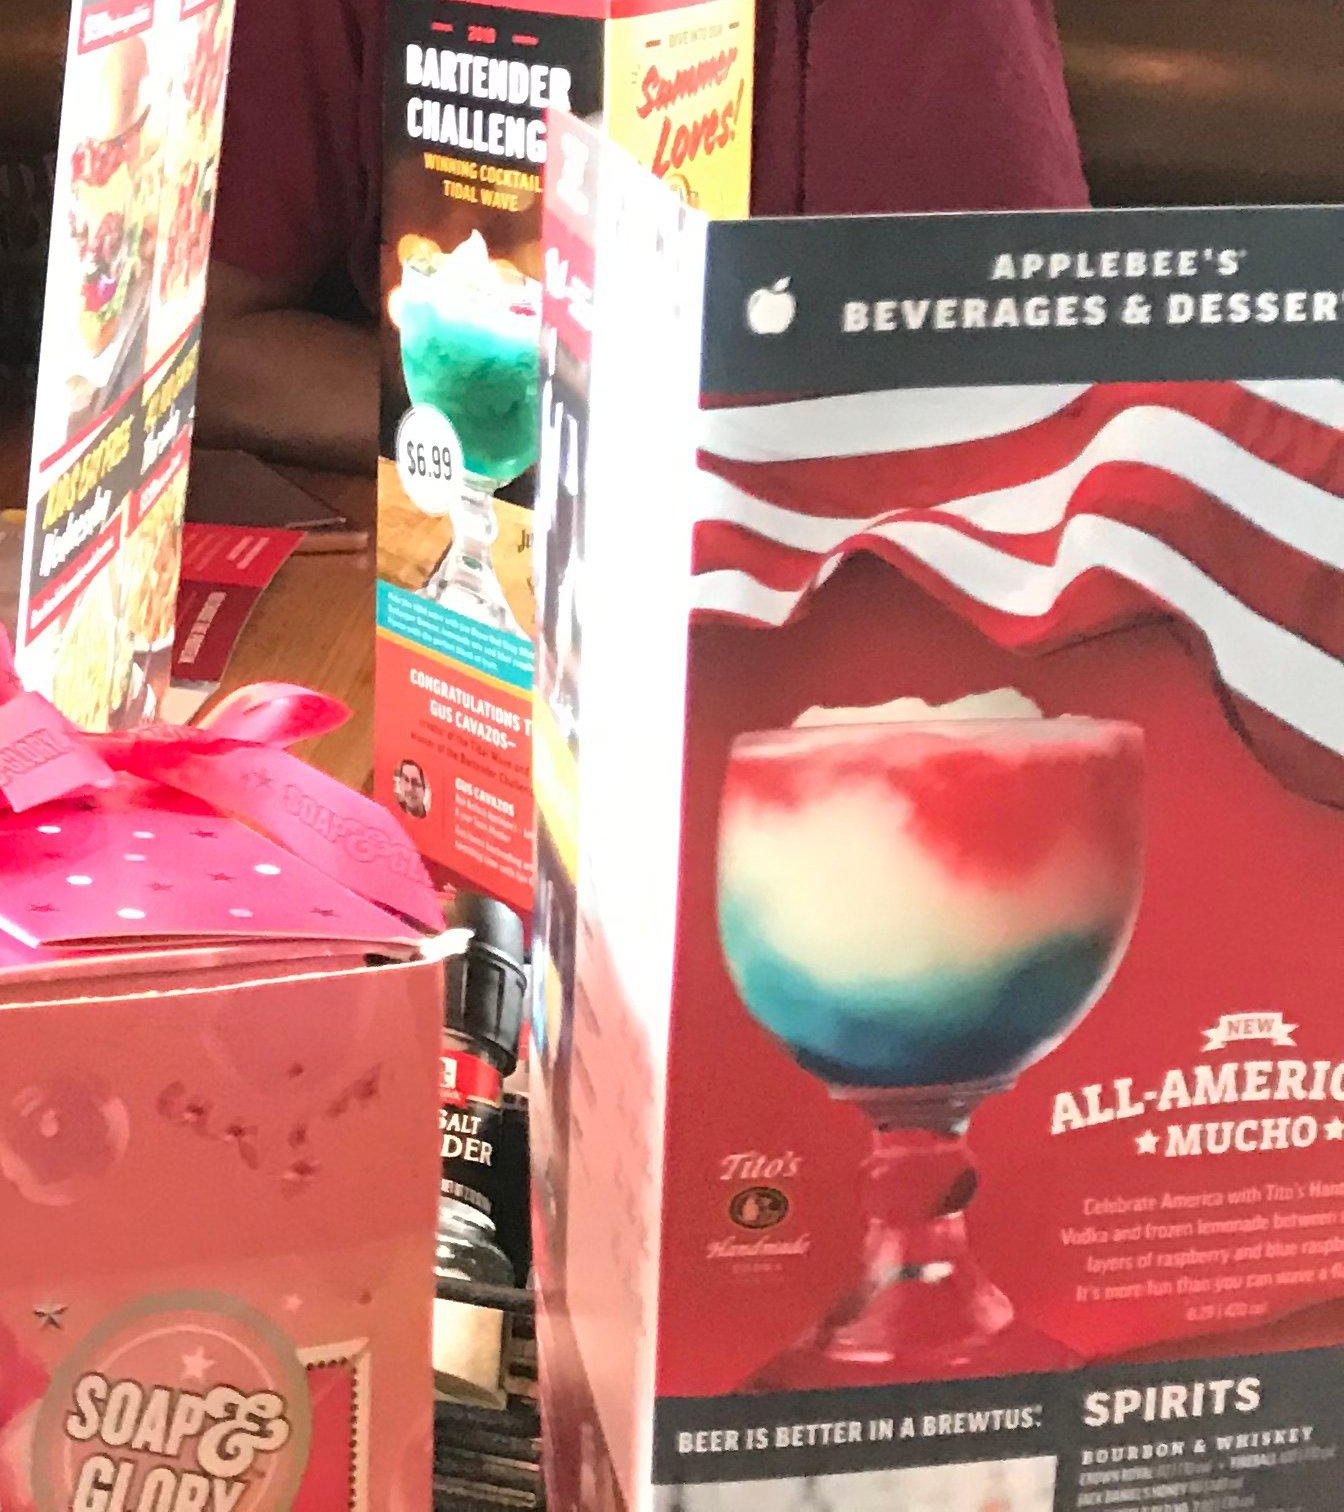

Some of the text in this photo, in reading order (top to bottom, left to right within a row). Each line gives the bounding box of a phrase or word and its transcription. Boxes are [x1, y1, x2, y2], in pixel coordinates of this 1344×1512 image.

[405, 43, 572, 111] BARTENDER
[637, 47, 740, 119] Summer
[406, 97, 548, 164] CHALLENG
[651, 78, 746, 179] Loves!
[443, 179, 520, 212] TIDAL WAVE
[990, 248, 1241, 281] APPLEBEE'S
[843, 290, 1343, 333] BEVERAGES & DESSER
[407, 440, 452, 481] $6.99
[409, 668, 534, 738] CONGRATULATIONS T
[430, 699, 454, 726] GUS
[1227, 1018, 1276, 1037] NEW
[1165, 1115, 1318, 1158] MUCHO
[720, 1150, 803, 1180] Tito's
[1083, 1197, 1157, 1216] Celebrate
[1161, 1191, 1224, 1210] America
[1227, 1187, 1262, 1206] with
[1060, 1227, 1108, 1246] Vodka
[1113, 1224, 1141, 1242] and
[1145, 1221, 1193, 1240] frozen
[1197, 1214, 1269, 1235] lemonade
[1086, 1235, 1343, 1275] layers of raspberry and blue raspb
[1104, 1281, 1143, 1300] more
[1147, 1279, 1173, 1297] fun
[1176, 1276, 1213, 1296] than
[1215, 1276, 1243, 1294] you
[1246, 1273, 1273, 1289] can
[1083, 1376, 1261, 1427] SPIRITS
[677, 1429, 740, 1454] BEER
[745, 1427, 769, 1451] IS
[775, 1421, 862, 1449] BETTER
[868, 1418, 894, 1441] IN
[899, 1415, 915, 1439] A
[1081, 1425, 1313, 1466] BOURBON & WHISKEY
